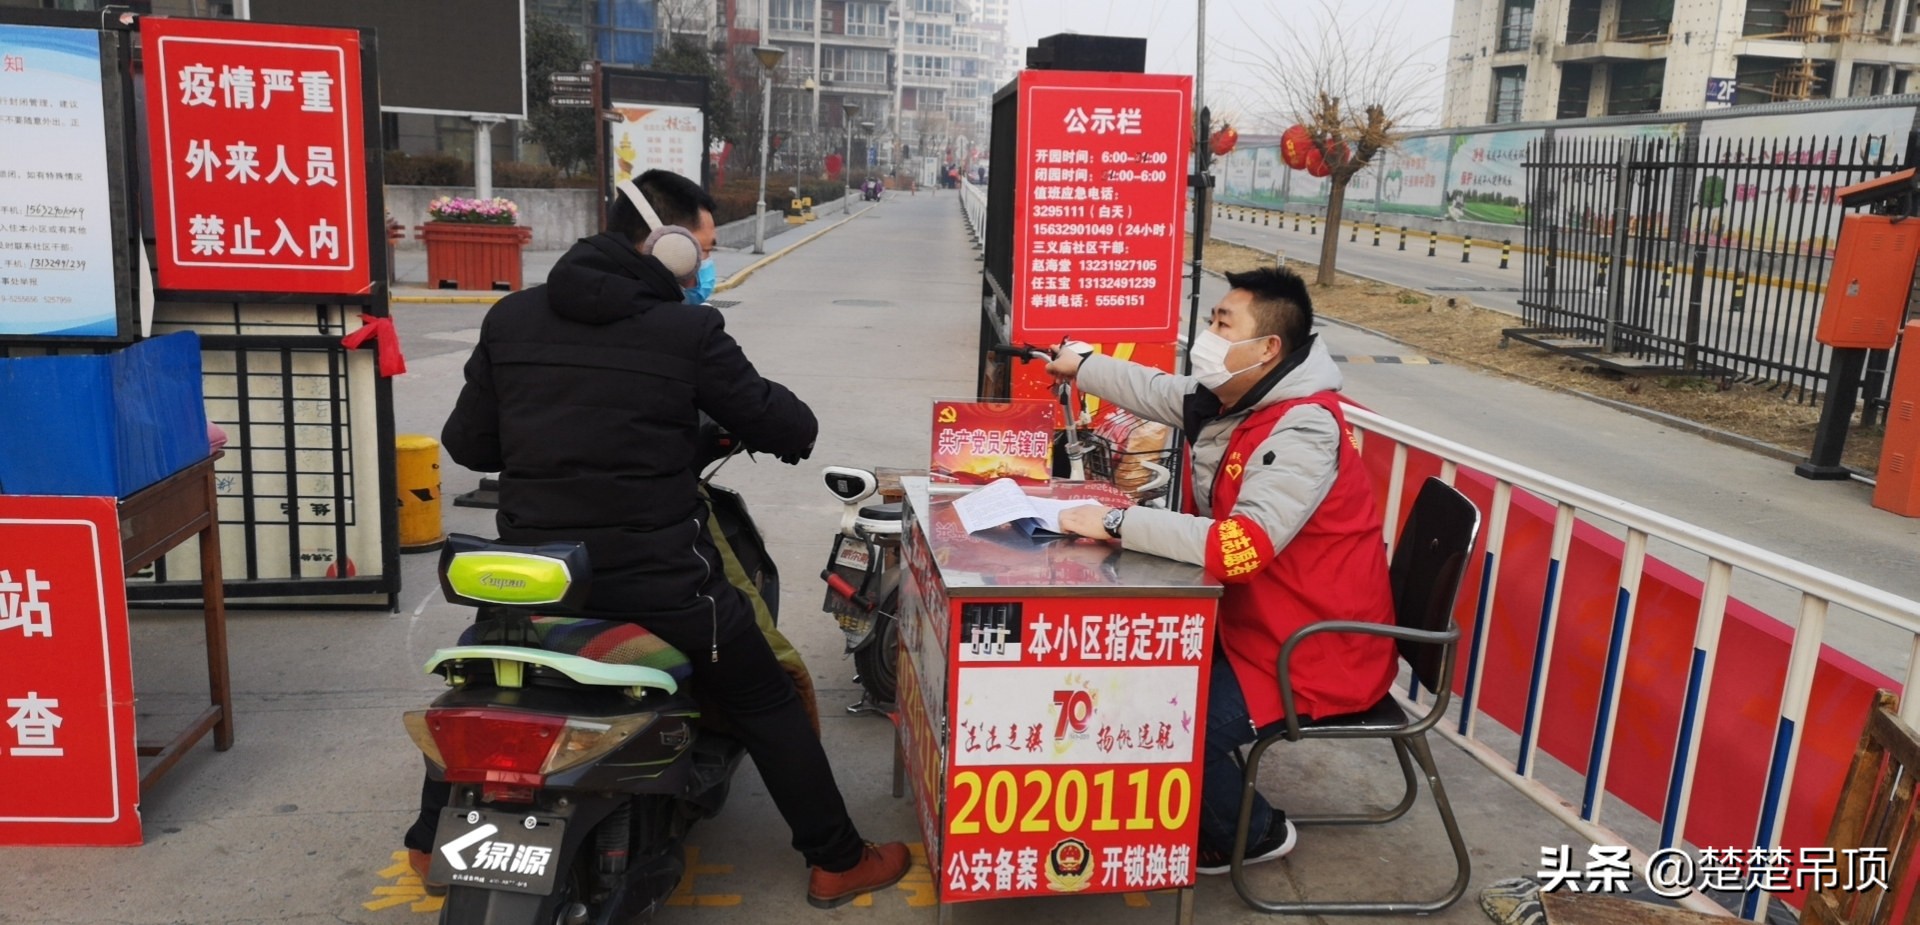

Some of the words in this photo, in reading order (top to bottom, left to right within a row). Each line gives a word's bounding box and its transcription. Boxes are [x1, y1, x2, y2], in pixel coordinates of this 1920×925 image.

[4, 54, 24, 72] 知
[179, 64, 334, 112] 疫情严重
[1717, 81, 1737, 100] 2F
[1064, 107, 1142, 135] 公示栏
[185, 140, 338, 187] 外来人员
[189, 215, 339, 260] 禁止入内
[1078, 278, 1156, 289] 13132491239
[1079, 260, 1157, 271] 13231927105
[938, 429, 1048, 457] 共产党员先锋岗
[0, 569, 53, 637] 站
[1028, 612, 1206, 662] 本小区指定开锁
[7, 692, 64, 757] 查
[1053, 690, 1093, 741] 70
[949, 768, 1192, 835] 2020110
[472, 841, 552, 876] 绿源
[947, 847, 1039, 892] 公安备案
[1101, 845, 1190, 888] 开锁换锁
